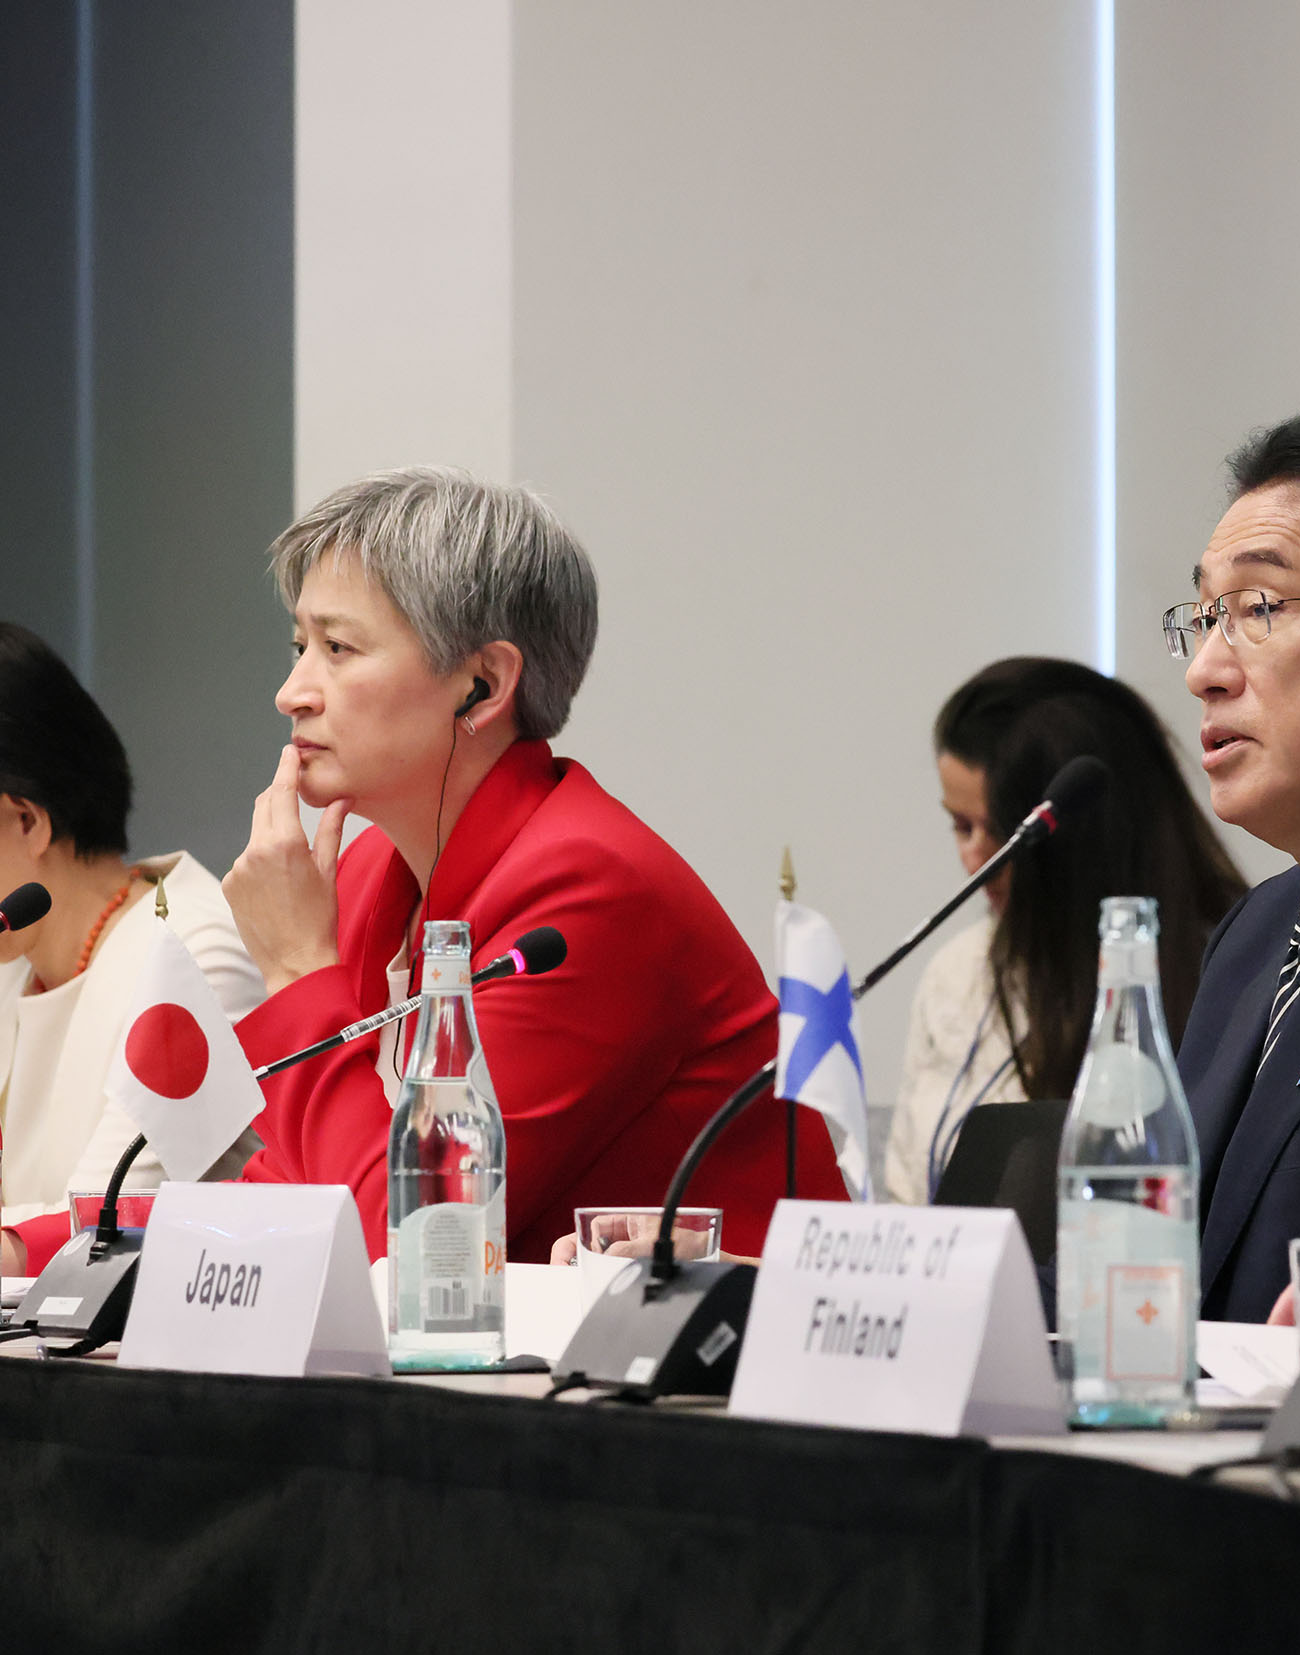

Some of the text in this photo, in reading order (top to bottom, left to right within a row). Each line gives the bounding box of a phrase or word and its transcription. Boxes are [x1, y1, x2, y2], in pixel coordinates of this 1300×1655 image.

[795, 1215, 962, 1279] Republic of
[186, 1248, 262, 1312] Japan
[804, 1297, 909, 1361] Finland
